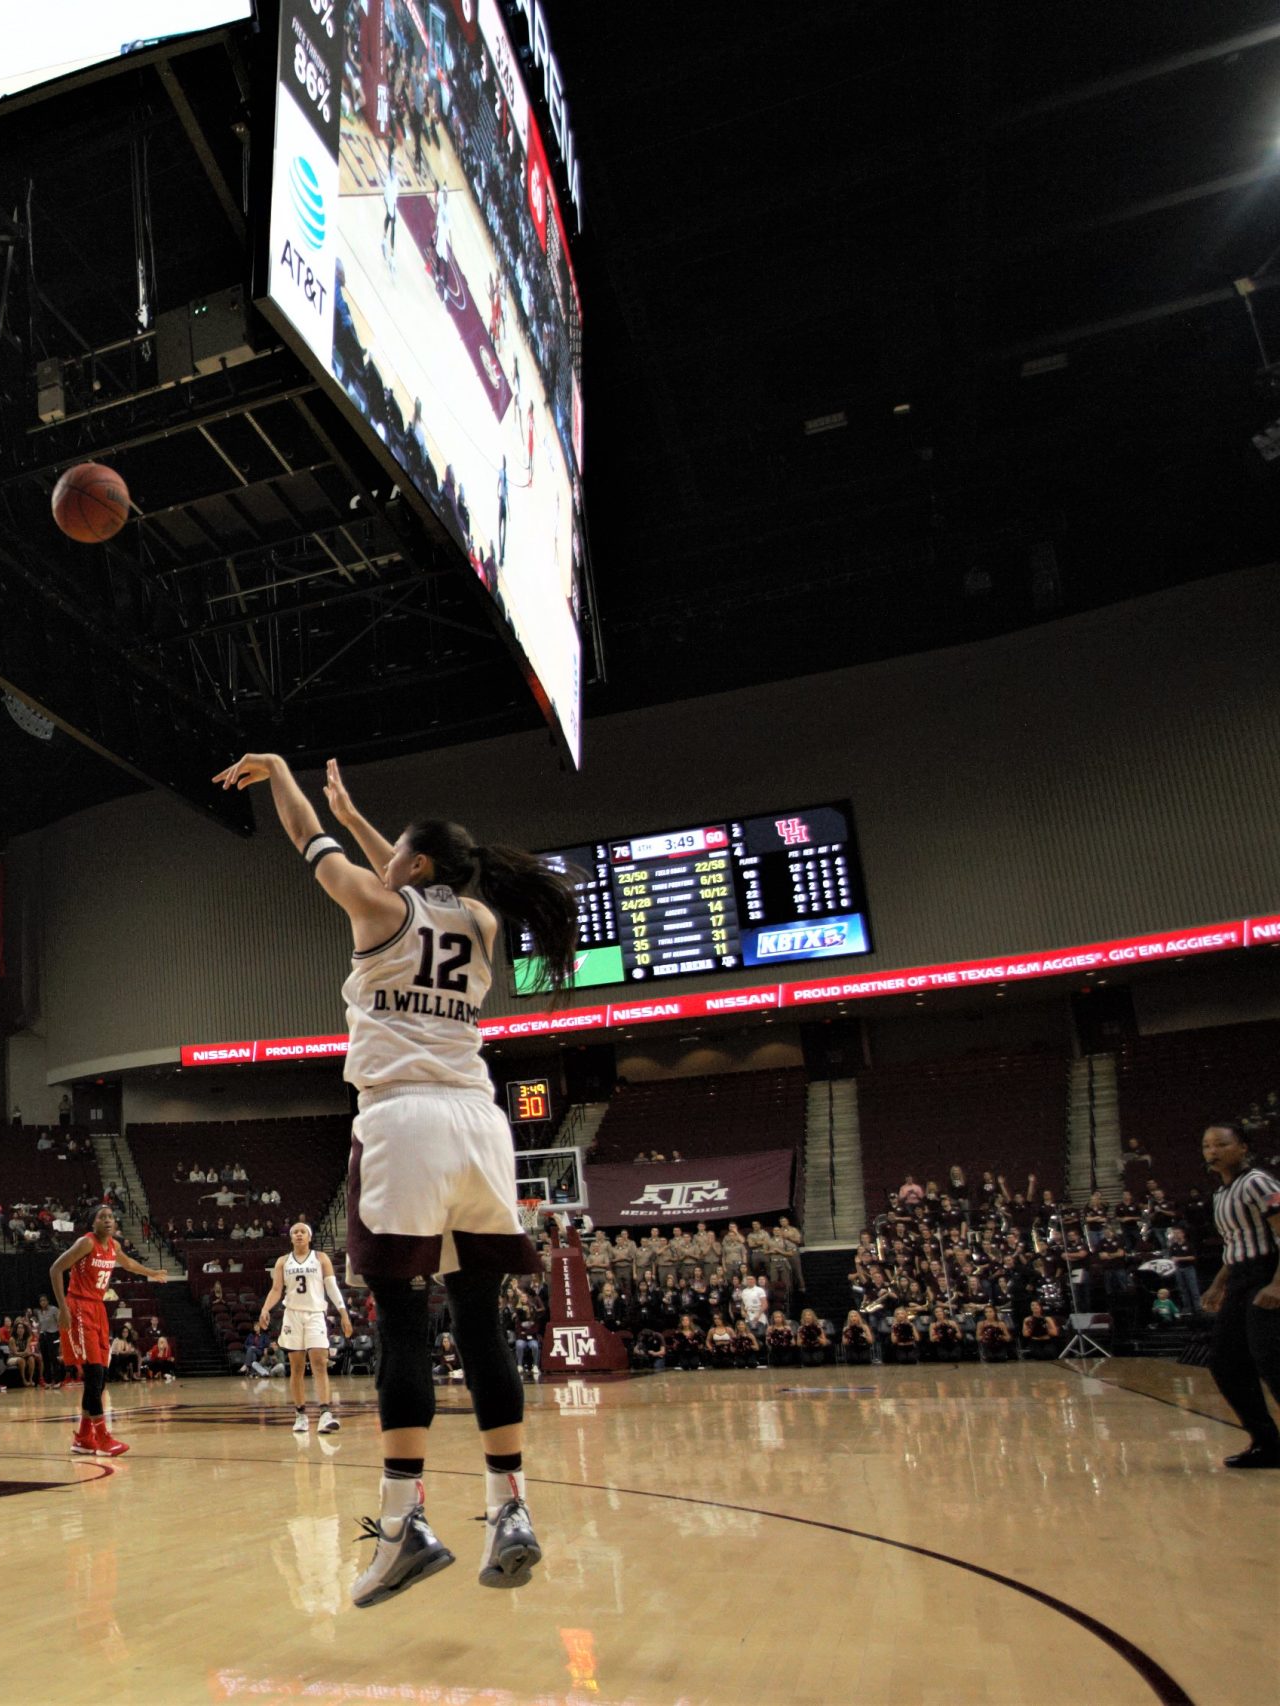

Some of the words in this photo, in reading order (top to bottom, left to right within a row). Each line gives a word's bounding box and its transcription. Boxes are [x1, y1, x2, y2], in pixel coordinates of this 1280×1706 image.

[294, 43, 331, 123] 86%
[280, 239, 327, 316] AT&T
[732, 827, 741, 837] 2
[596, 849, 606, 859] 3
[613, 847, 629, 858] 76
[665, 836, 695, 850] 3:49
[706, 831, 724, 843] 60
[734, 847, 744, 856] 4
[598, 868, 607, 878] 2
[618, 871, 648, 884] 23/50
[695, 859, 726, 872] 22/58
[789, 863, 802, 872] 12
[806, 861, 815, 870] 4
[820, 859, 828, 868] 3
[835, 857, 844, 865] 4
[623, 885, 646, 897] 6/12
[700, 873, 723, 885] 6/13
[746, 890, 759, 899] 22
[794, 884, 803, 892] 4
[809, 882, 818, 890] 2
[838, 878, 846, 886] 4
[750, 881, 758, 889] 2
[807, 871, 816, 879] 3
[822, 870, 829, 878] 1
[837, 867, 845, 875] 3
[621, 898, 651, 911] 24/28
[699, 887, 728, 899] 10/12
[748, 901, 760, 909] 23
[793, 894, 807, 902] 10
[810, 892, 819, 900] 7
[840, 888, 848, 896] 3
[631, 912, 645, 924] 14
[708, 901, 723, 913] 14
[749, 911, 763, 920] 33
[797, 905, 806, 913] 2
[812, 903, 821, 911] 2
[633, 926, 646, 937] 17
[710, 915, 724, 927] 17
[633, 940, 649, 952] 35
[712, 930, 726, 941] 31
[761, 929, 821, 954] KBTX
[413, 927, 472, 994] 12
[635, 954, 650, 965] 10
[714, 943, 727, 955] 11
[793, 986, 841, 1000] PROUD
[843, 979, 905, 994] PARTNER
[907, 976, 928, 987] OF
[928, 972, 957, 984] THE
[959, 966, 1004, 980] TEXAS
[1007, 962, 1040, 975] A&M
[613, 1003, 680, 1020] NISSAN
[706, 992, 775, 1010] NISSAN
[193, 1048, 250, 1061] NISSAN
[266, 1046, 304, 1057] PROUD
[520, 1084, 545, 1097] 3:49
[519, 1097, 543, 1118] 30
[662, 1205, 729, 1216] ROWDIES
[285, 1267, 304, 1275] TEXAS
[562, 1258, 571, 1296] TEXAS
[296, 1275, 306, 1294] 3
